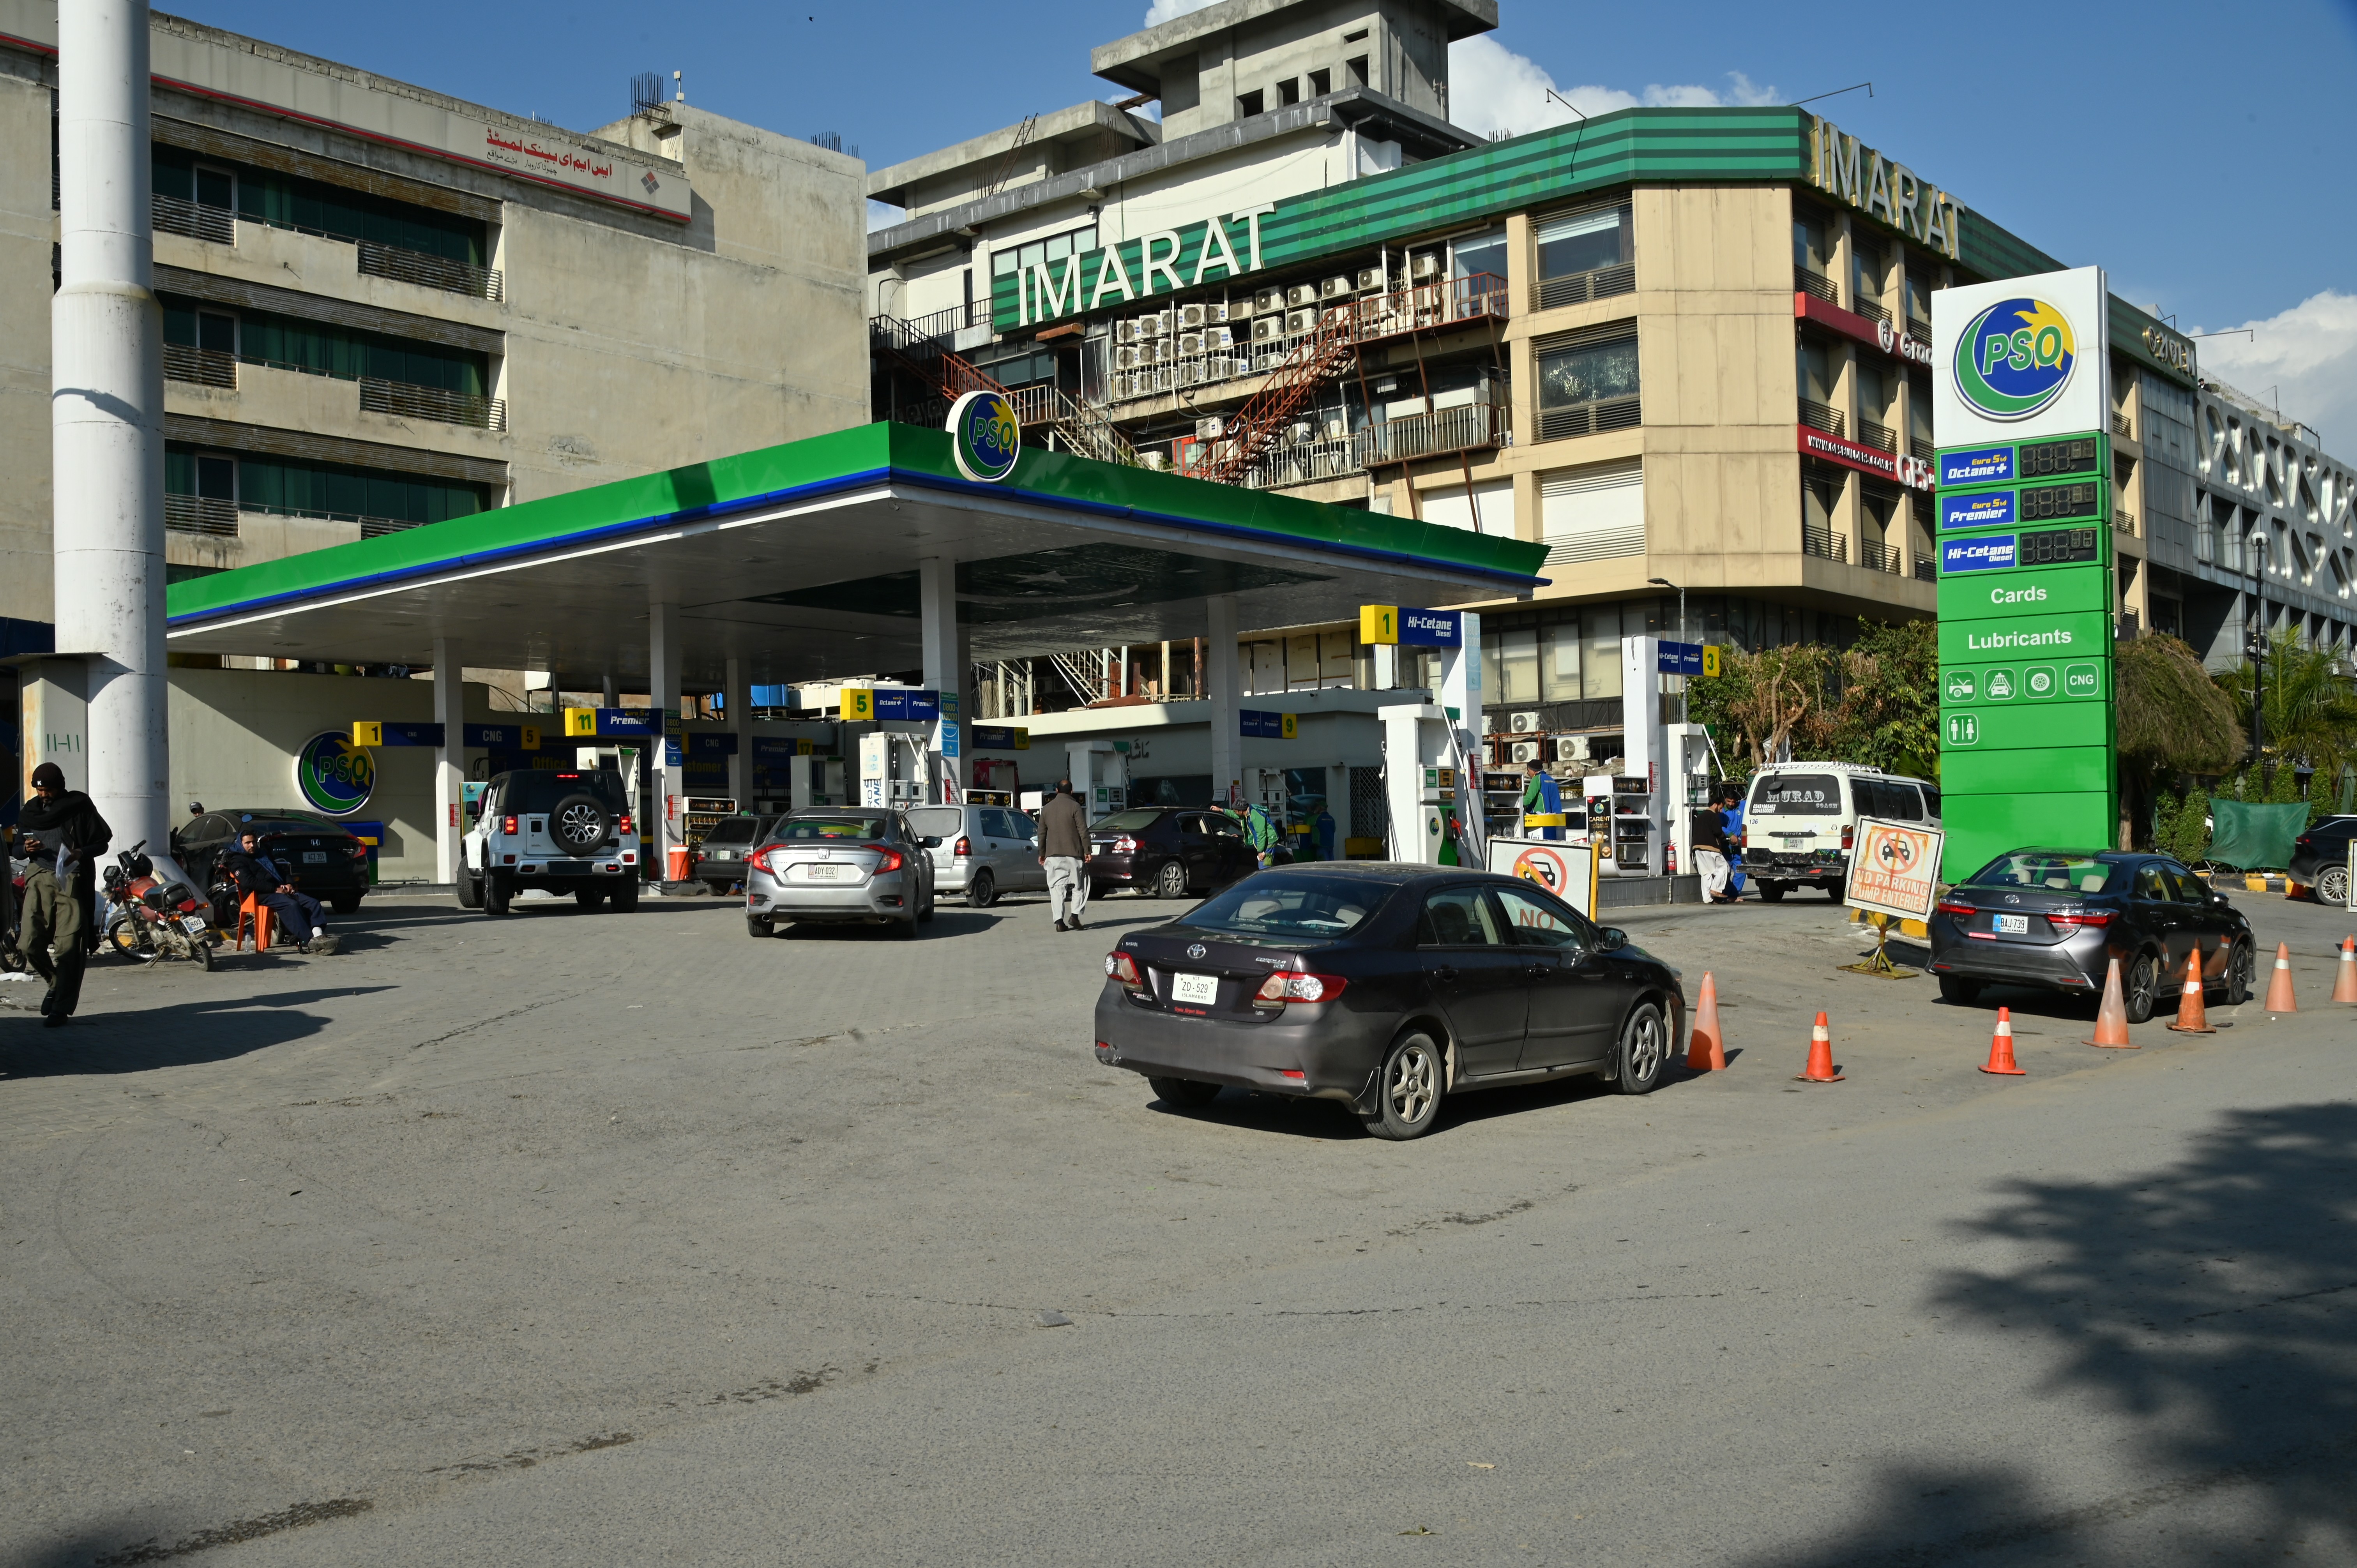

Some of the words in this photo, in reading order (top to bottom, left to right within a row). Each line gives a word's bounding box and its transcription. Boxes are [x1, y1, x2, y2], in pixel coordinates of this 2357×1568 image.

[1814, 115, 1965, 261] IMARAT
[1018, 203, 1276, 327] IMARAT
[1982, 325, 2062, 375] PSO
[973, 417, 1014, 449] PSO
[1993, 454, 2000, 463] 5
[1896, 453, 1929, 491] GFS
[1993, 498, 2000, 507] 5
[1950, 509, 2007, 523] Premier
[1948, 545, 2014, 559] Hi-Cetane
[1988, 554, 2012, 562] Diesel
[1991, 586, 2047, 604] Cards
[1383, 613, 1390, 634] 1
[1408, 616, 1452, 630] Hi-Cetane
[1968, 629, 2072, 649] Lubricants
[1707, 653, 1714, 670] 3
[2070, 674, 2094, 686] CNG
[857, 695, 867, 712] 5
[578, 714, 591, 730] 11
[610, 716, 650, 724] Premier
[942, 712, 957, 720] 03000
[1286, 719, 1293, 733] 9
[371, 726, 378, 741] 1
[483, 730, 502, 742] CNG
[527, 730, 533, 743] 5
[1015, 731, 1027, 745] 15
[705, 739, 719, 747] CNG
[761, 745, 788, 753] Premier
[319, 755, 368, 783] PSO
[532, 756, 567, 770] Office
[682, 761, 721, 773] ustomer
[1766, 791, 1825, 802] MURAD
[1855, 870, 1872, 884] NO
[1875, 874, 1928, 896] PARKING
[1852, 883, 1880, 901] PUMP
[1881, 888, 1926, 911] ENTERIES
[190, 919, 202, 927] 803
[1520, 909, 1554, 930] NO
[1196, 984, 1208, 993] 529
